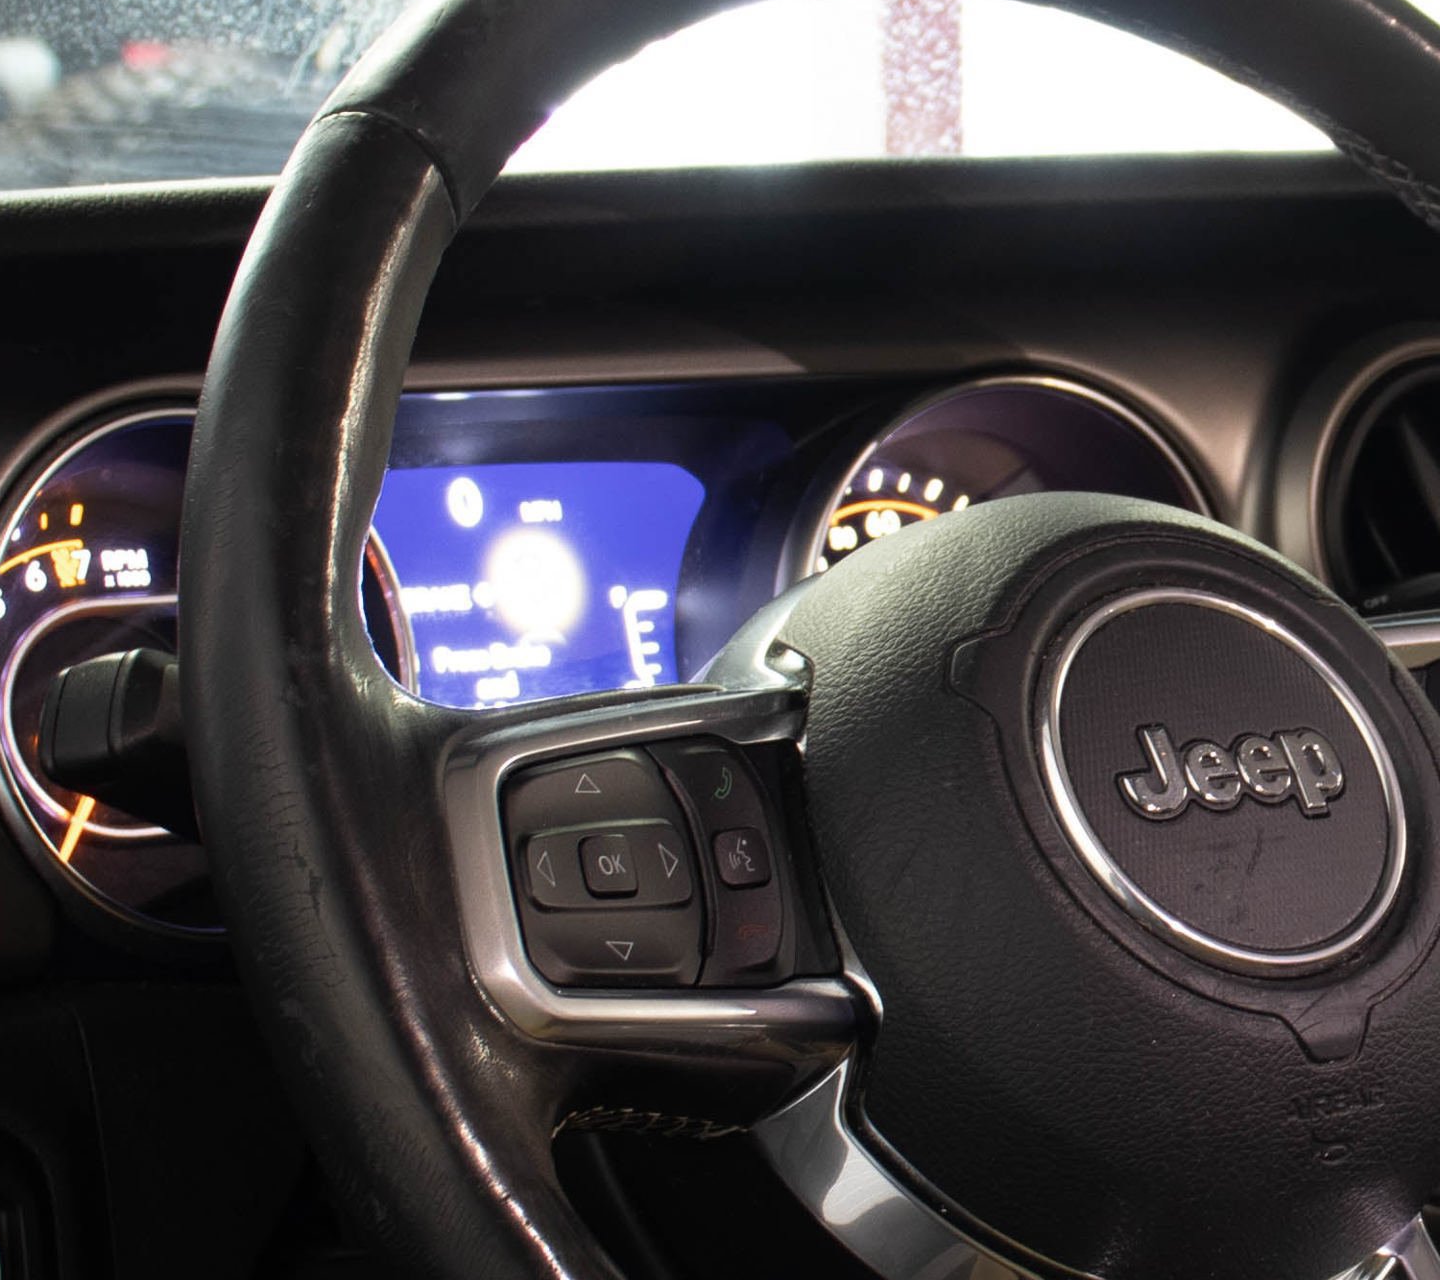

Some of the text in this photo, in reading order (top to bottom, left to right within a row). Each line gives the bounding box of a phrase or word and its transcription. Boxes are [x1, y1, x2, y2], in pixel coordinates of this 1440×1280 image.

[70, 548, 92, 580] 7
[101, 548, 149, 571] RPM
[25, 560, 47, 592] 6
[1117, 724, 1345, 819] Jeep
[598, 854, 627, 877] OK
